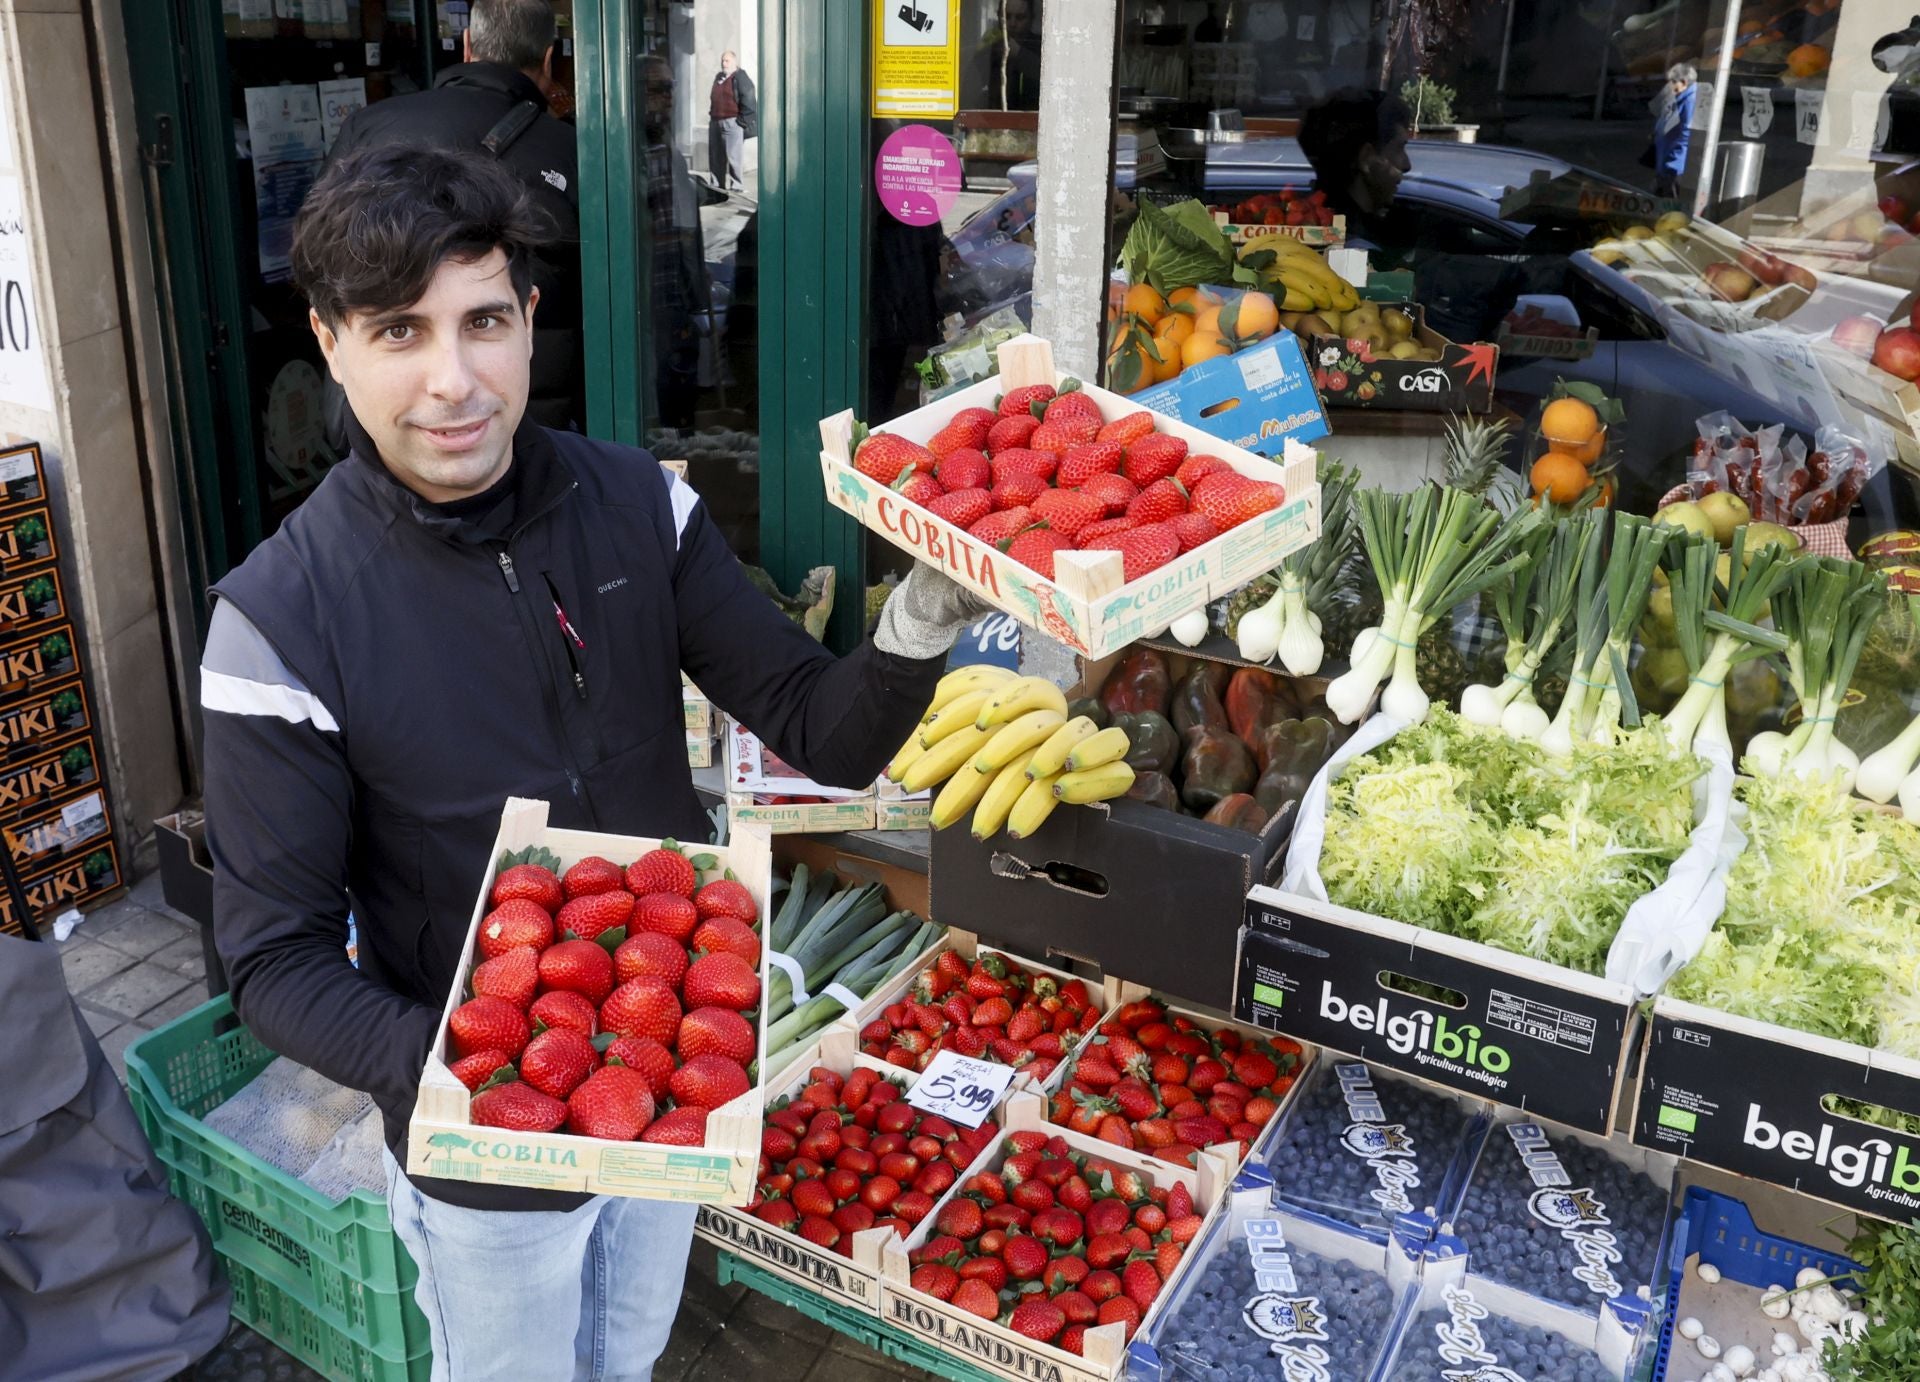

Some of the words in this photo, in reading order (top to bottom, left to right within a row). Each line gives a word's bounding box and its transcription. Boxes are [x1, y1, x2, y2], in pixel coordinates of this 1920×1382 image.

[1398, 375, 1441, 392] CASI
[877, 496, 1001, 598] COBITA
[1133, 558, 1208, 610] COBITA
[754, 809, 800, 820] COBITA
[1320, 980, 1511, 1073] belgibio
[1514, 1022, 1521, 1030] 6
[1529, 1027, 1537, 1035] 8
[1542, 1031, 1555, 1040] 10
[1562, 1017, 1592, 1028] EXTRA
[920, 1075, 995, 1112] 5.99
[1335, 1064, 1387, 1122] BLUE
[1414, 1050, 1464, 1075] Agricultura
[1465, 1068, 1508, 1089] ecológica
[471, 1140, 578, 1168] COBITA
[1506, 1123, 1572, 1187] BLUE
[222, 1201, 312, 1268] centramirsa
[696, 1207, 845, 1291] HOLANDITA
[1243, 1219, 1298, 1293] BLUE
[1561, 1229, 1623, 1298] Kings
[892, 1298, 1065, 1382] HOLANDITA
[1435, 1283, 1498, 1364] Kings
